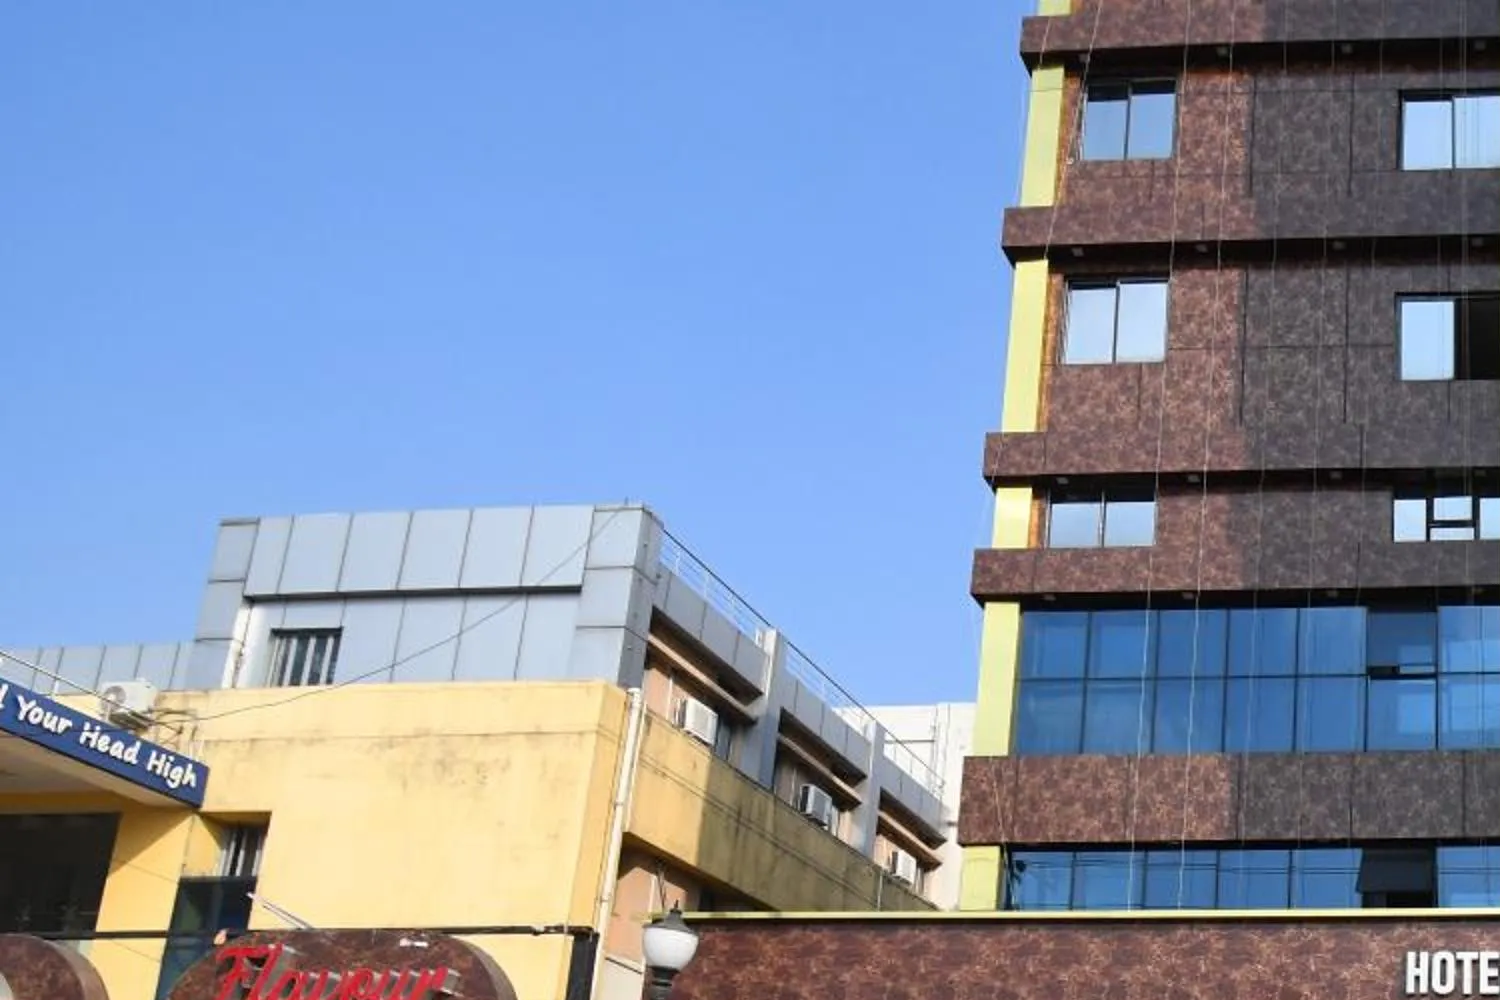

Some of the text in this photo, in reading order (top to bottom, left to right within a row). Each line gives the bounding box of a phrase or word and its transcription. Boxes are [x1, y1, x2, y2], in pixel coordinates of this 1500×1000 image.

[15, 694, 73, 735] Your
[79, 722, 142, 766] Head
[147, 750, 197, 790] High
